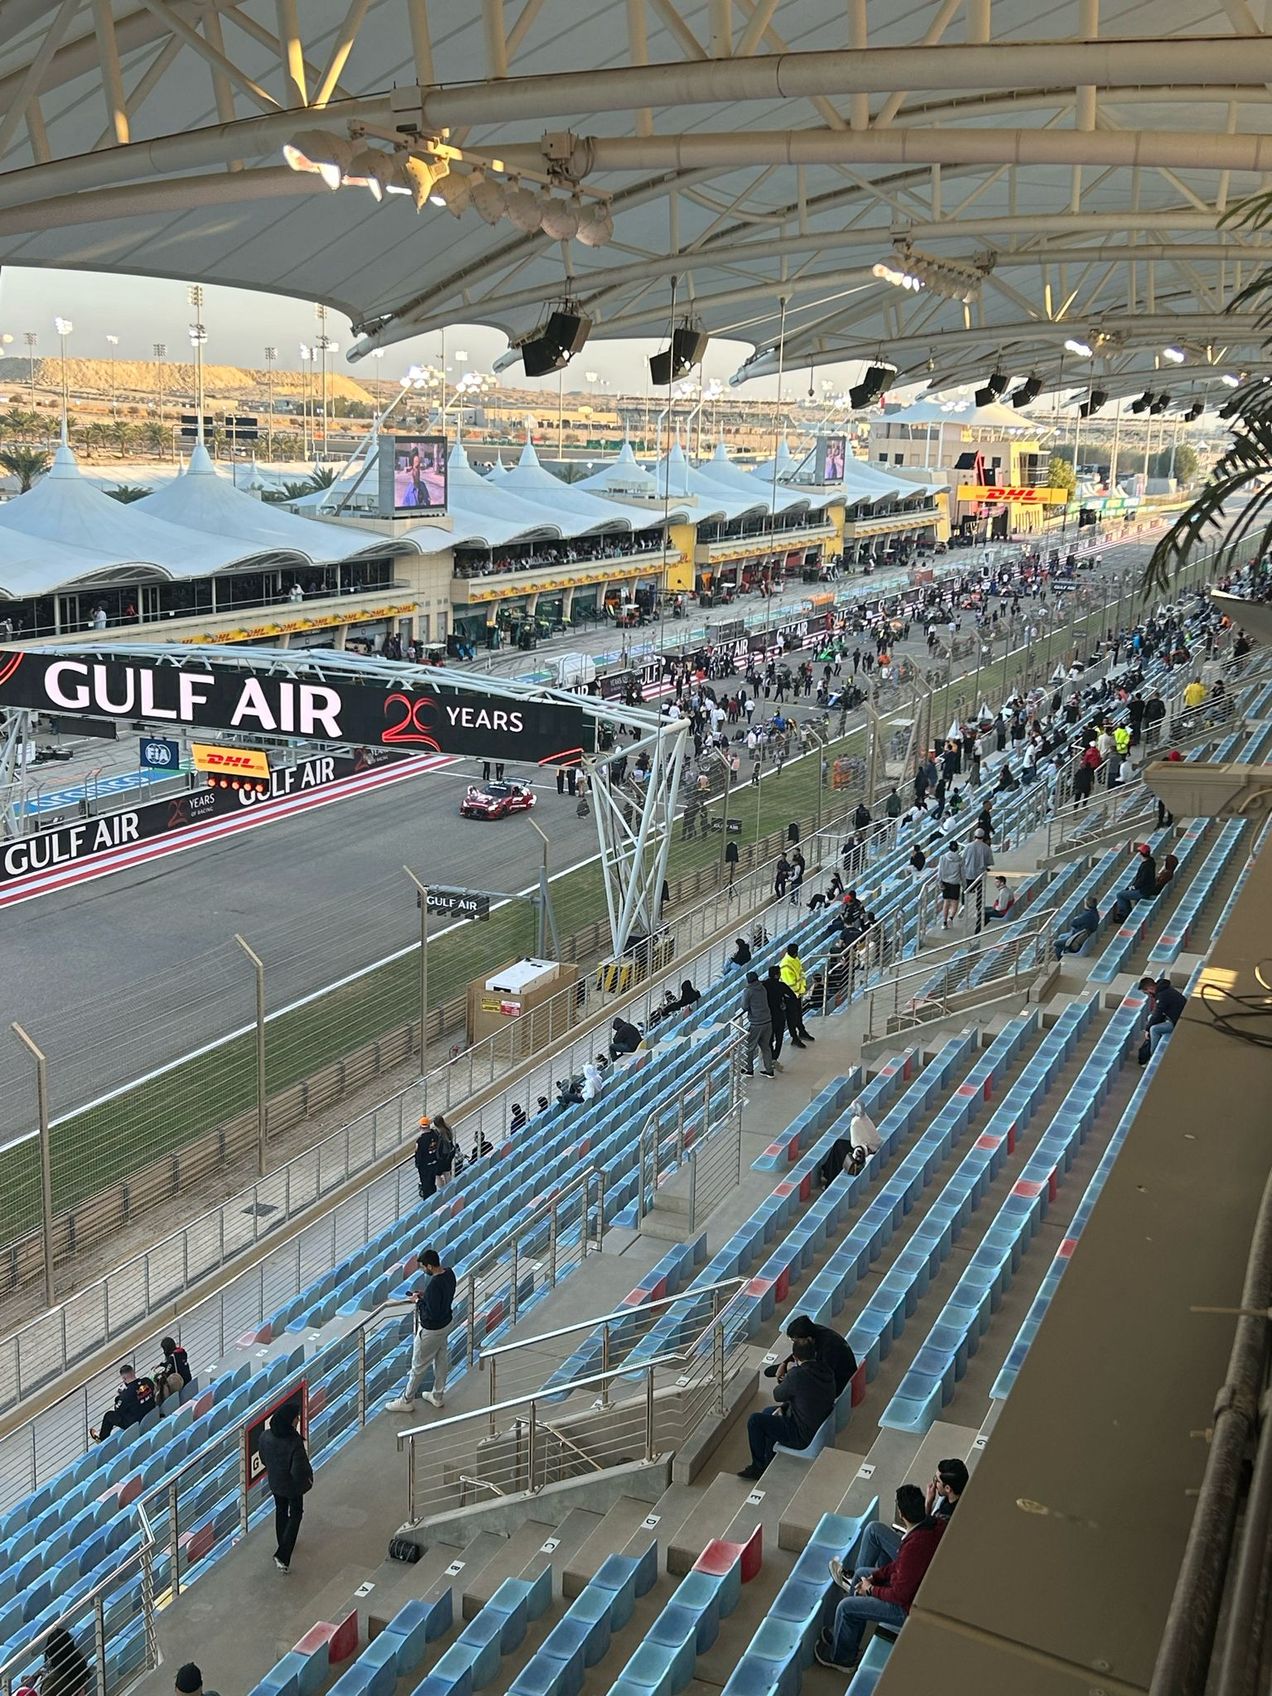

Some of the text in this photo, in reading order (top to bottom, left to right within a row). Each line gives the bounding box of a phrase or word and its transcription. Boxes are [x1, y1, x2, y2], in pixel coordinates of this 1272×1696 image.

[985, 489, 1038, 500] DHL
[734, 639, 749, 656] AIR
[44, 661, 214, 721] GULF
[230, 677, 343, 738] AIR
[446, 706, 524, 733] YEARS
[148, 748, 169, 762] FIA
[207, 753, 254, 769] DHL
[301, 757, 335, 789] AIR
[31, 777, 149, 807] aramco
[4, 825, 88, 876] GULF
[93, 812, 140, 850] AIR
[190, 793, 215, 809] YEARS
[426, 896, 477, 910] GULF AIR
